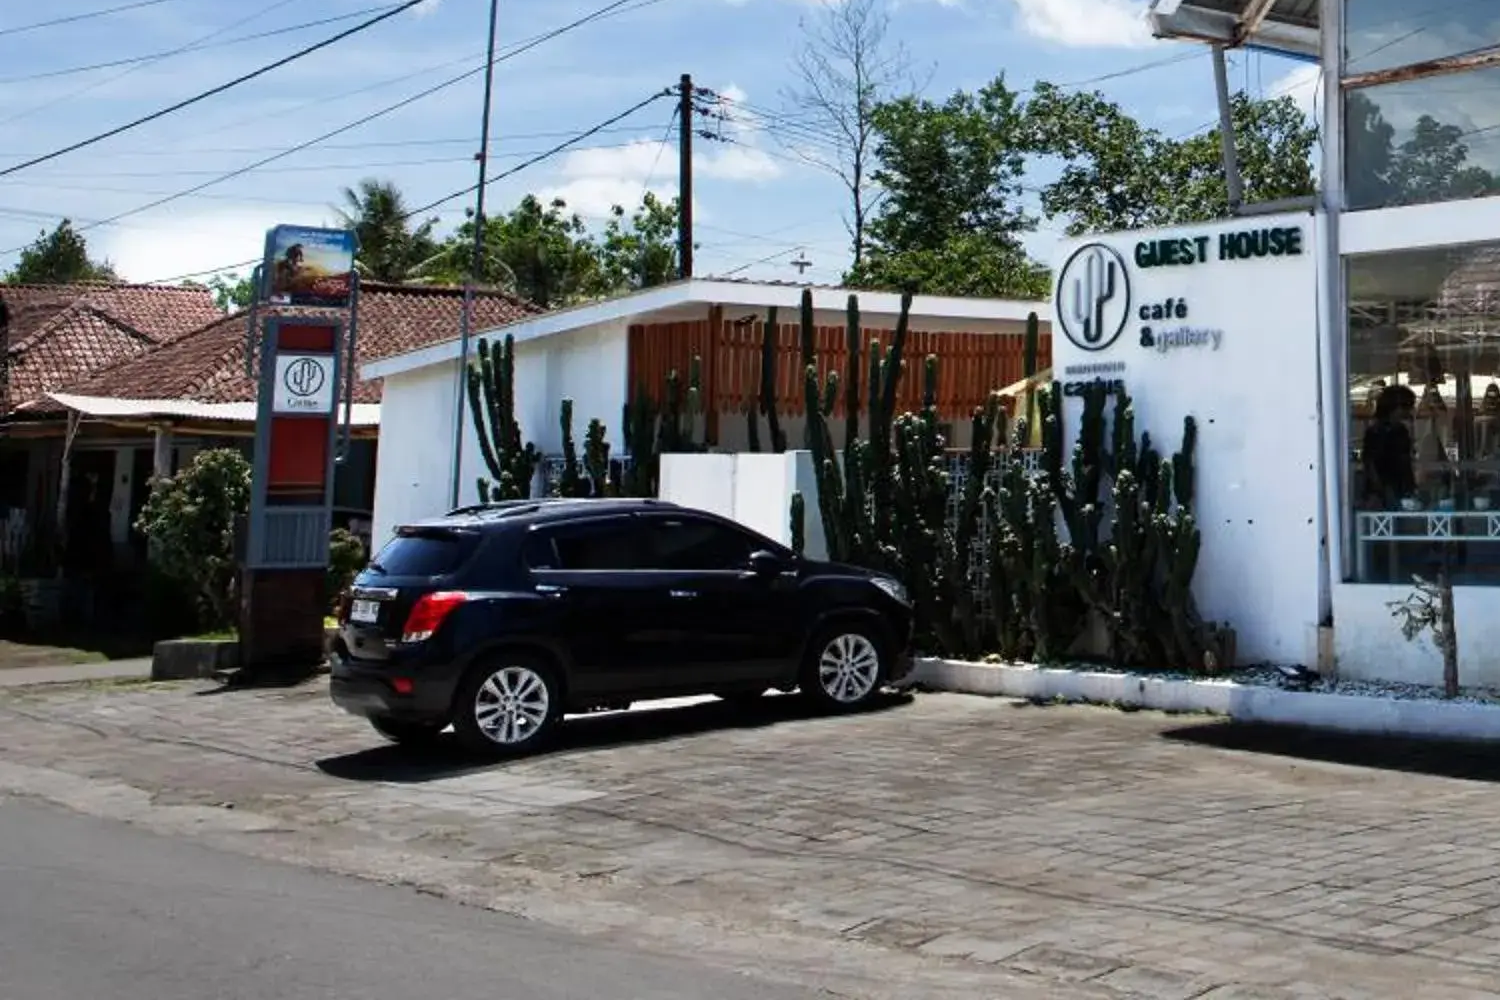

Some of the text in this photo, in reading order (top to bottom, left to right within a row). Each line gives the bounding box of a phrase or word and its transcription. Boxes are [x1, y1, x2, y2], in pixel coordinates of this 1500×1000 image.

[1134, 226, 1303, 268] GUEST HOUSE
[1138, 297, 1188, 321] café
